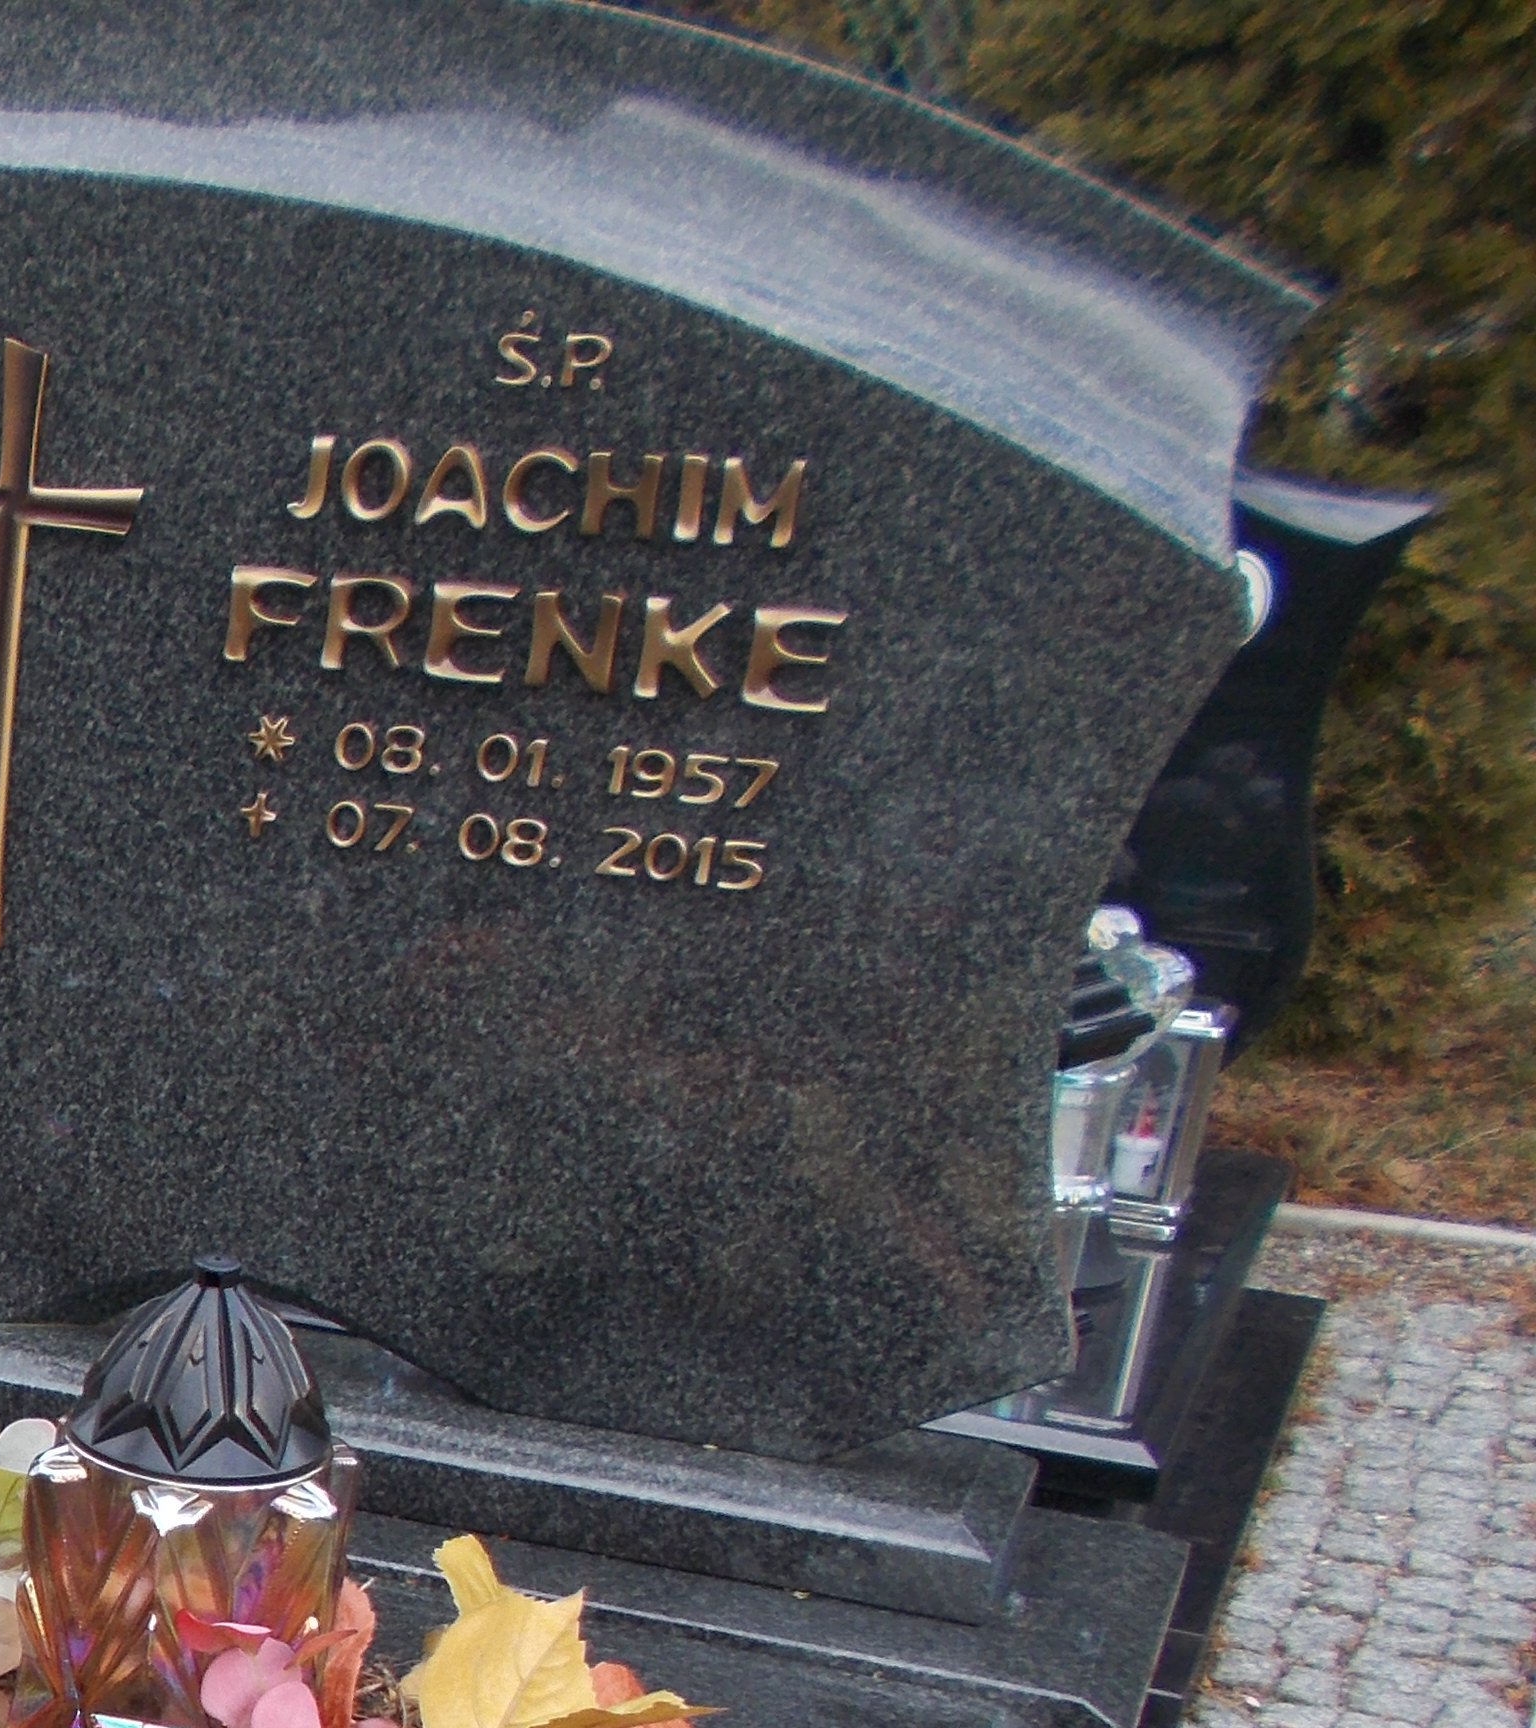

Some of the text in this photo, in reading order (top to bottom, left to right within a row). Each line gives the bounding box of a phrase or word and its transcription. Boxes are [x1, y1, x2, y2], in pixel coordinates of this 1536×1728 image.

[286, 433, 807, 548] JOACHIM
[223, 563, 849, 714] FRENKE
[333, 721, 780, 809] 08. 01. 1957
[326, 799, 767, 891] 07. 08. 2015
